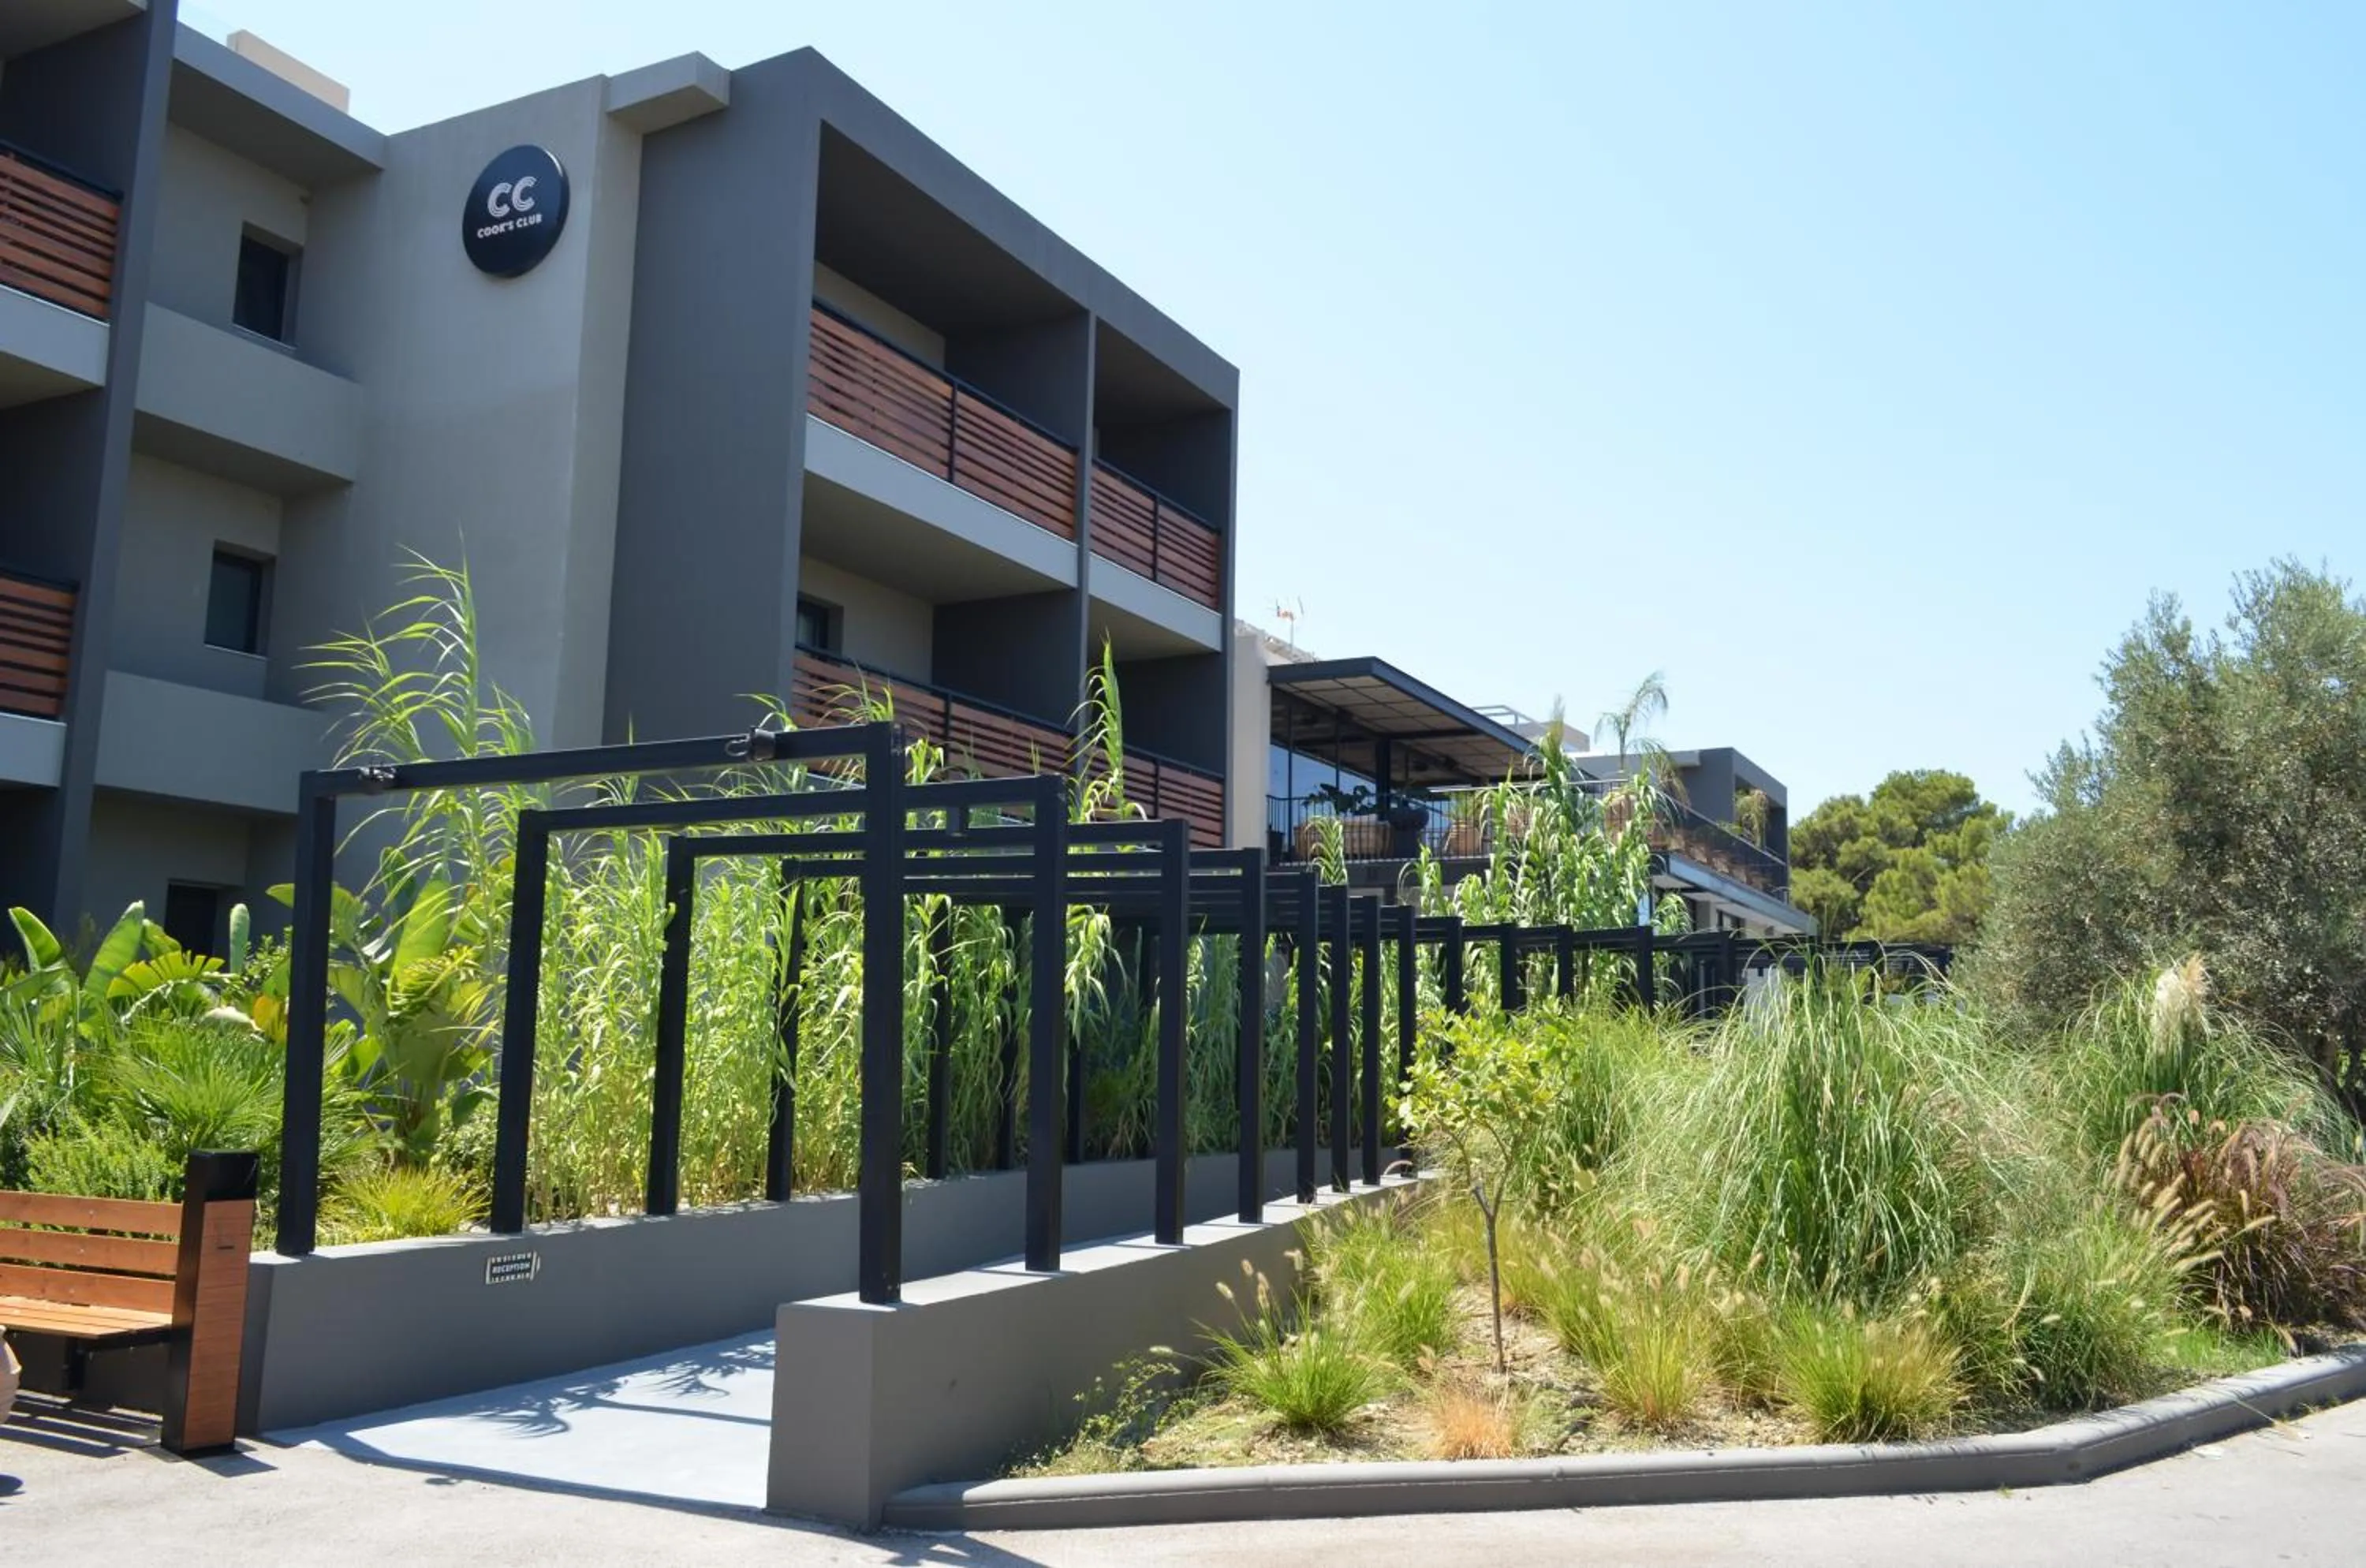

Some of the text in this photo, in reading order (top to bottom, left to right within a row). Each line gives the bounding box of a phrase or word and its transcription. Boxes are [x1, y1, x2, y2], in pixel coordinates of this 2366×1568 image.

[487, 176, 537, 218] CC
[477, 213, 543, 238] COOK'S CLUB
